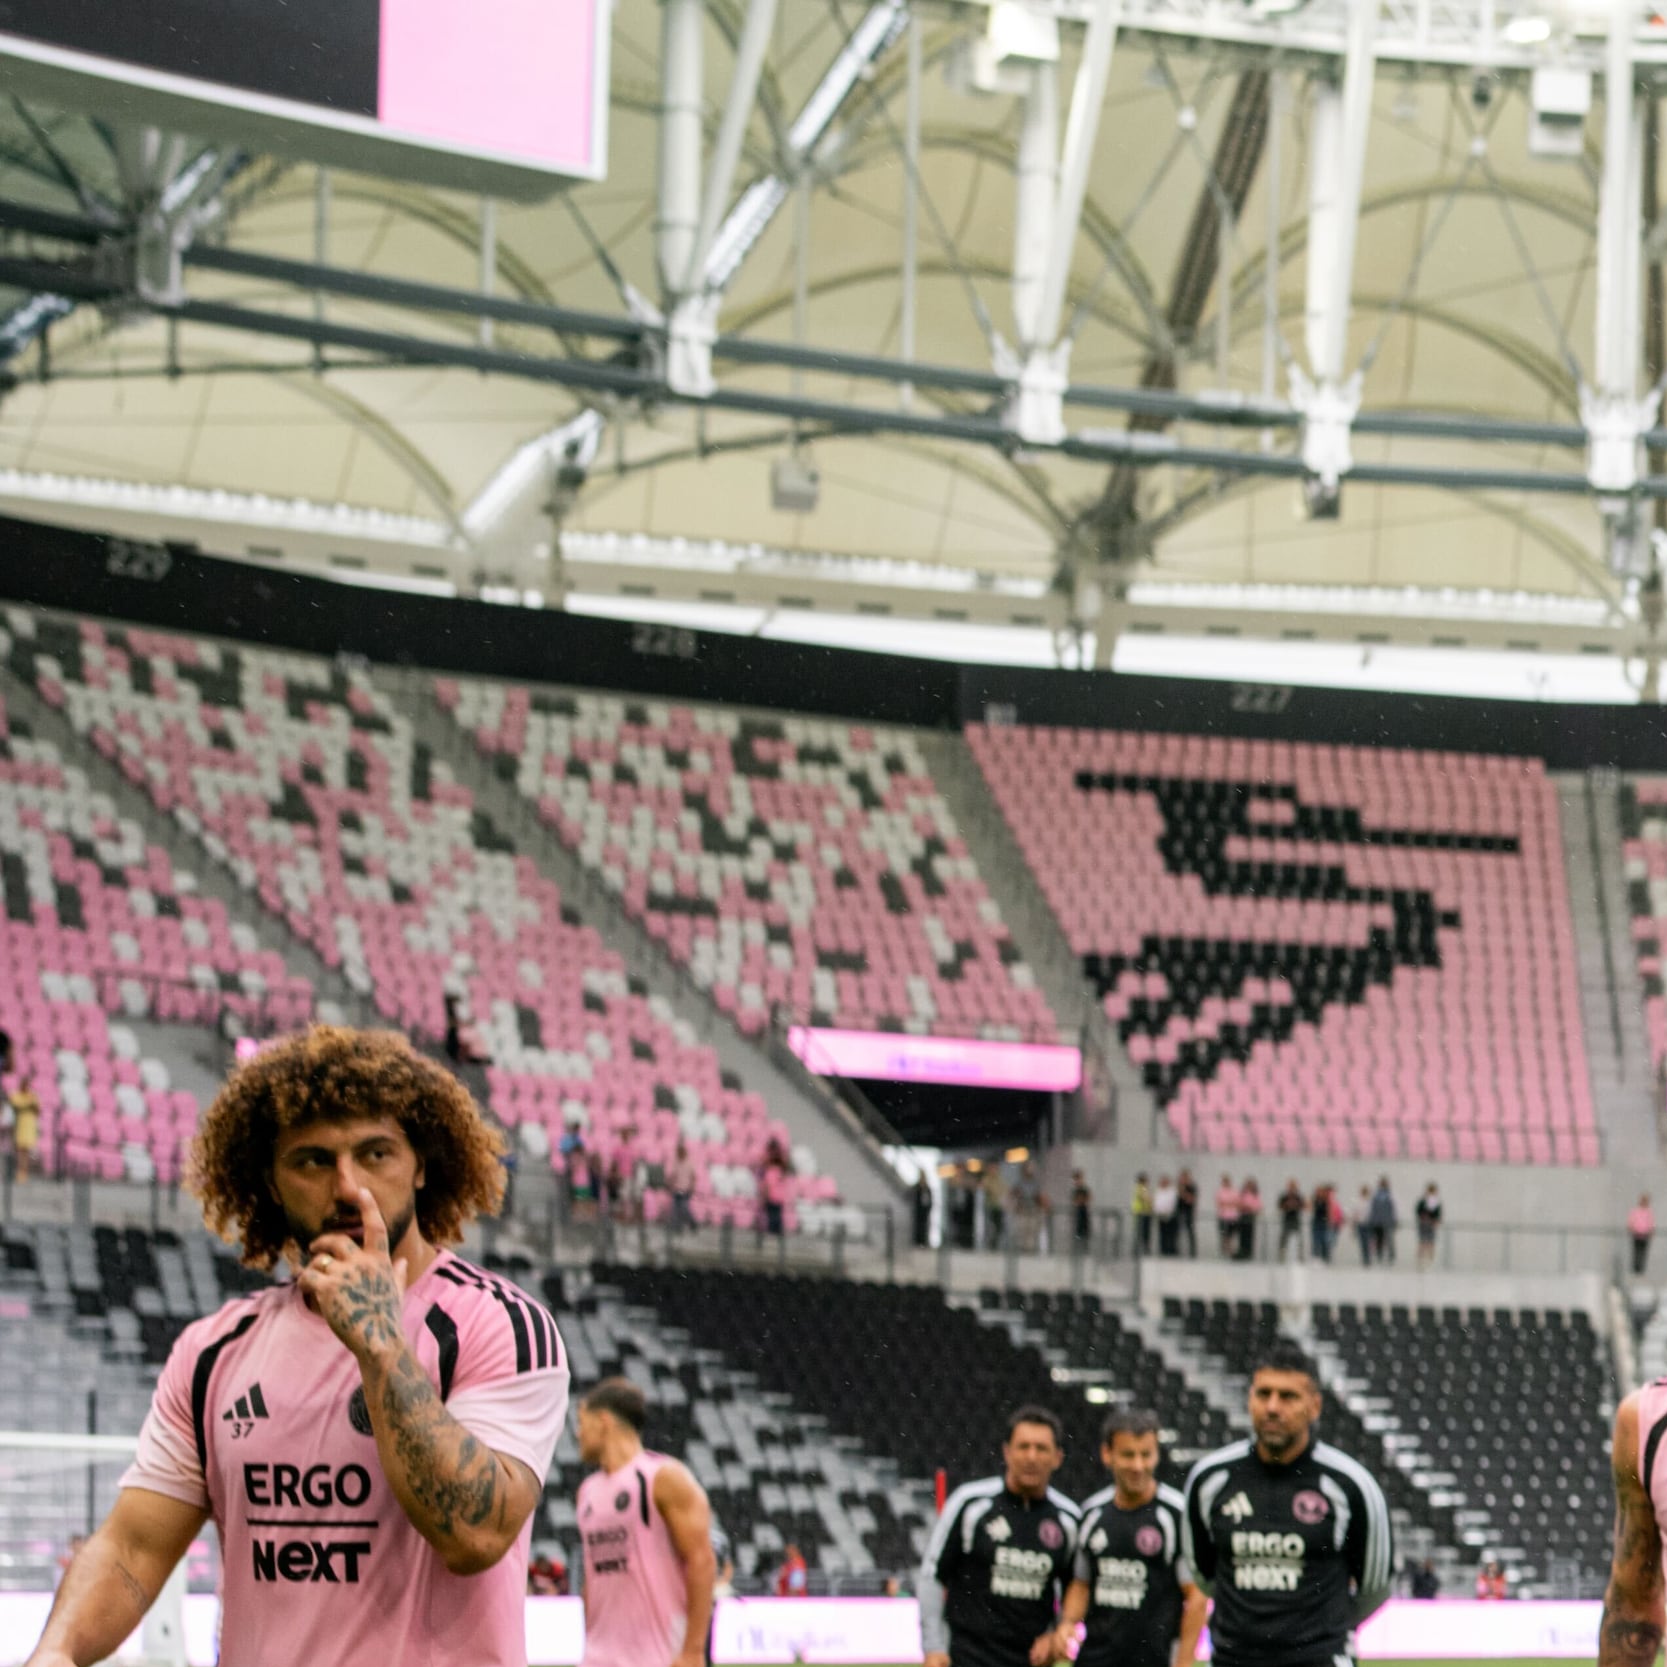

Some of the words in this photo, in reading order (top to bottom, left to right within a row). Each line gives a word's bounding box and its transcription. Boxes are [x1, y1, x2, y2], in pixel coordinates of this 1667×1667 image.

[230, 1422, 255, 1440] 37
[243, 1463, 372, 1508] ERGO
[1231, 1530, 1305, 1558] ERGO
[994, 1545, 1054, 1573] ERGO
